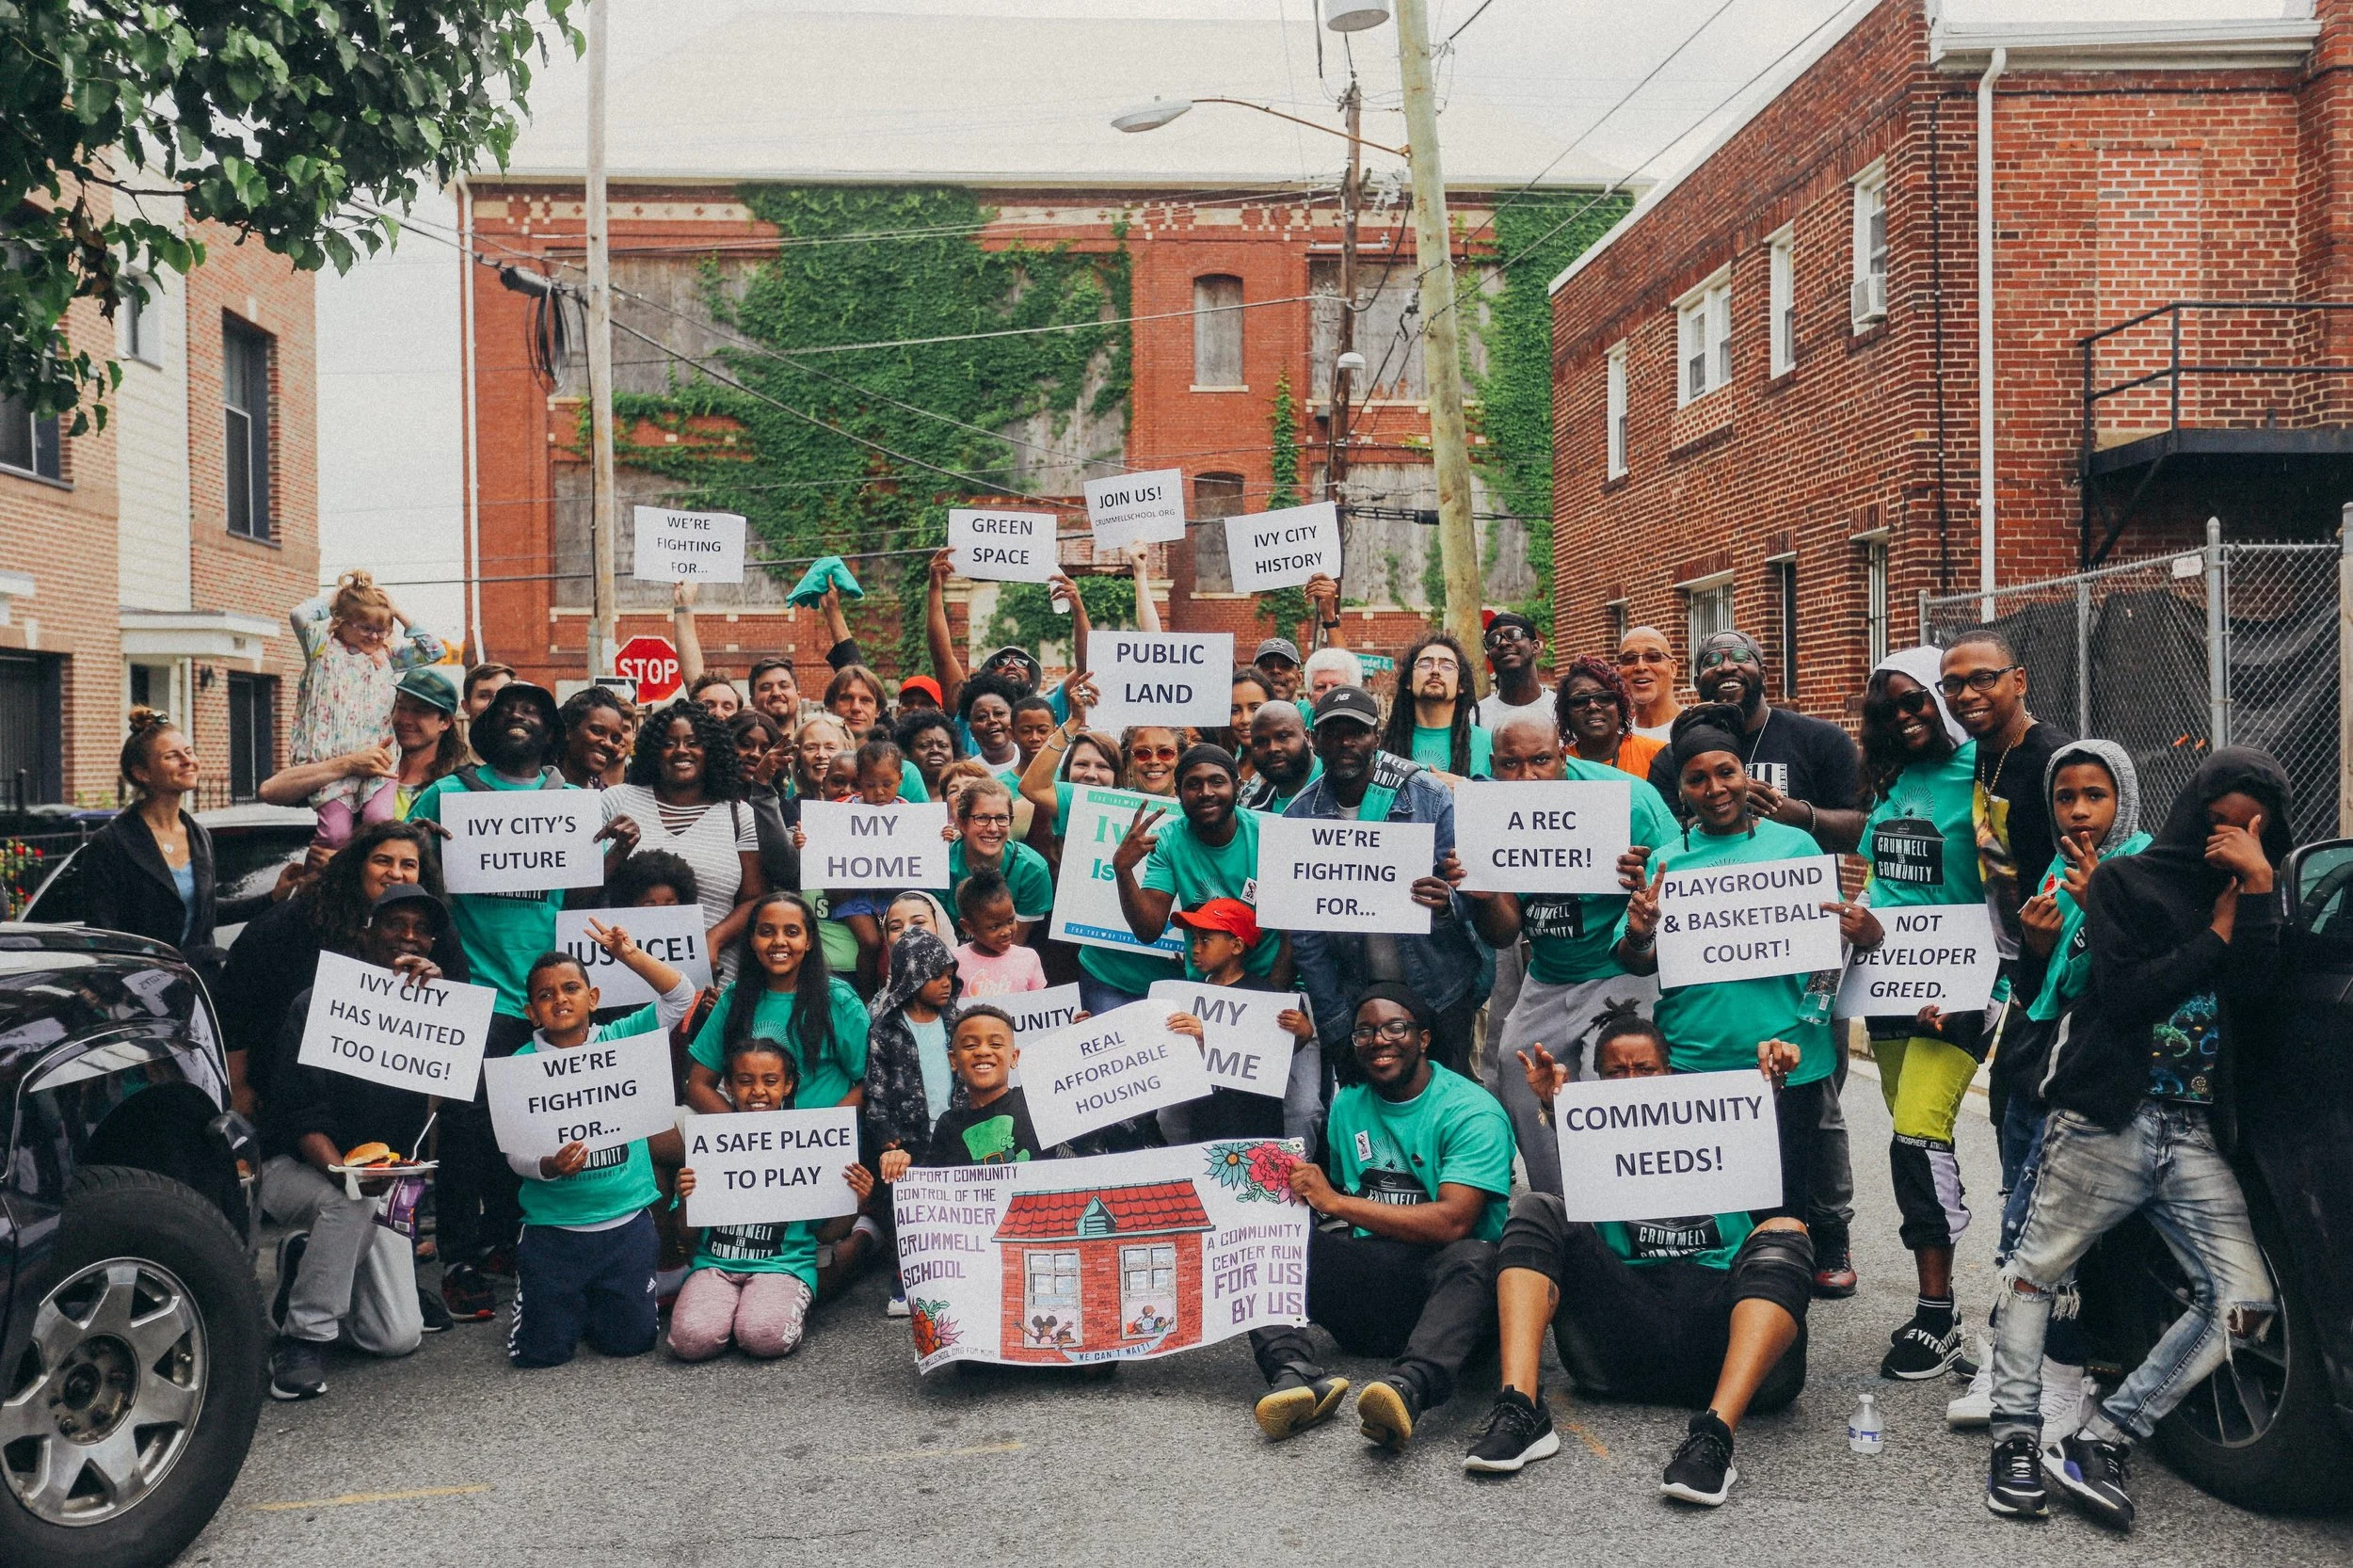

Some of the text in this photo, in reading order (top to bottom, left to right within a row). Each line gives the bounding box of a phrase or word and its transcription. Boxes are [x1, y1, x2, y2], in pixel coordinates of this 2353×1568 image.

[1100, 486, 1161, 508] JOIN US!
[667, 517, 711, 530] WE'RE
[972, 518, 1032, 536] GREEN
[657, 537, 722, 552] FIGHTING
[1255, 525, 1318, 548] IVY CITY
[972, 547, 1030, 565] SPACE
[1256, 552, 1323, 574] HISTORY
[671, 562, 708, 574] FOR...
[1117, 643, 1205, 664] PUBLIC
[619, 658, 679, 684] STOP
[1126, 683, 1193, 704] LAND
[468, 815, 576, 836] IVY CITY'S
[851, 815, 899, 836] MY
[1094, 815, 1131, 845] Iv
[1508, 810, 1577, 830] A REC
[1312, 828, 1381, 847] WE'RE
[1878, 837, 1928, 857] CRUMMELL
[481, 851, 566, 870] FUTURE
[828, 856, 922, 877] HOME
[1092, 857, 1115, 881] Is
[1492, 848, 1593, 868] CENTER!
[1293, 862, 1396, 882] FIGHTING
[1664, 867, 1823, 899] PLAYGROUND
[1878, 861, 1932, 882] COMMUNITY
[1317, 898, 1376, 916] FOR...
[1663, 902, 1830, 934] & BASKETBALL
[1896, 915, 1943, 933] NOT
[568, 935, 696, 967] JUSCE!
[1703, 939, 1791, 964] COURT!
[1854, 949, 1977, 966] DEVELOPER
[360, 972, 449, 1006] IVY CITY
[1869, 982, 1947, 999] GREED.
[1012, 1006, 1075, 1032] UNITY
[1193, 996, 1248, 1026] MY
[329, 1000, 466, 1046] HAS WAITED
[1080, 1031, 1126, 1056] REAL
[330, 1036, 451, 1080] TOO LONG!
[543, 1050, 617, 1078] WE'RE
[1053, 1044, 1169, 1094] AFFORDABLE
[1206, 1048, 1261, 1080] ME
[528, 1080, 638, 1114] FIGHTING
[1075, 1075, 1162, 1114] HOUSING
[1566, 1095, 1763, 1131] COMMUNITY
[557, 1121, 621, 1144] FOR...
[692, 1128, 851, 1154] A SAFE PLACE
[1615, 1145, 1723, 1177] NEEDS!
[724, 1166, 822, 1190] TO PLAY
[954, 1166, 1017, 1183] COMMUNITY
[897, 1188, 996, 1202] CONTROL OF THE
[897, 1205, 996, 1227] ALEXANDER
[900, 1232, 985, 1258] CRUMMELL
[1207, 1224, 1302, 1251] A COMMUNITY
[1639, 1226, 1707, 1246] CRUMMELL
[1212, 1245, 1302, 1272] CENTER RUN
[904, 1260, 966, 1289] SCHOOL
[1215, 1263, 1303, 1299] FOR US
[1232, 1292, 1303, 1325] BY US
[1079, 1341, 1151, 1361] WE CAN'T WAIT!
